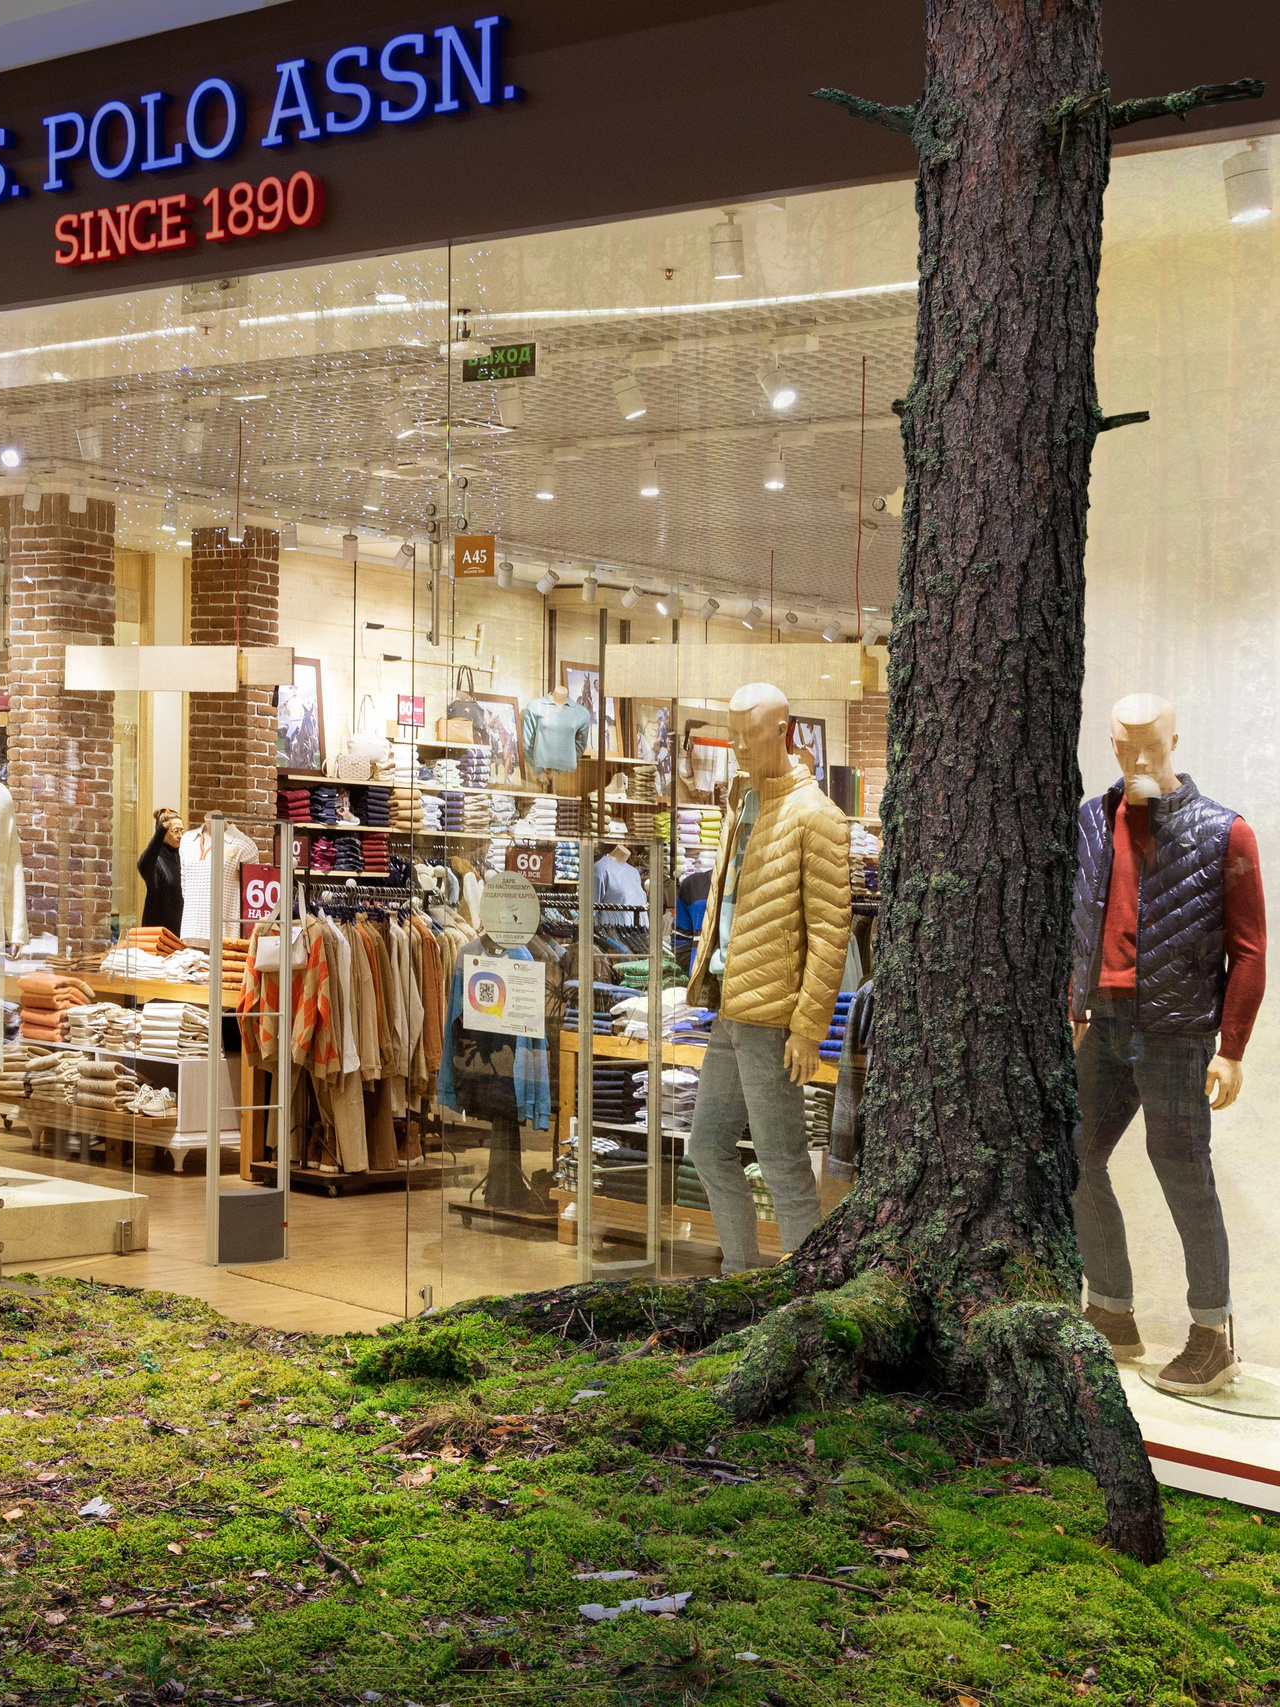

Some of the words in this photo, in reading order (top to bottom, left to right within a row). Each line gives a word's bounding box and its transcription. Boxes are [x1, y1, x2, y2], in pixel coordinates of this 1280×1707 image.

[42, 77, 240, 191] POLO
[261, 15, 517, 148] ASSN.
[54, 194, 190, 266] SINCE
[203, 170, 320, 242] 1890
[477, 365, 521, 379] EXIT
[462, 549, 487, 564] A45
[247, 909, 261, 918] НА
